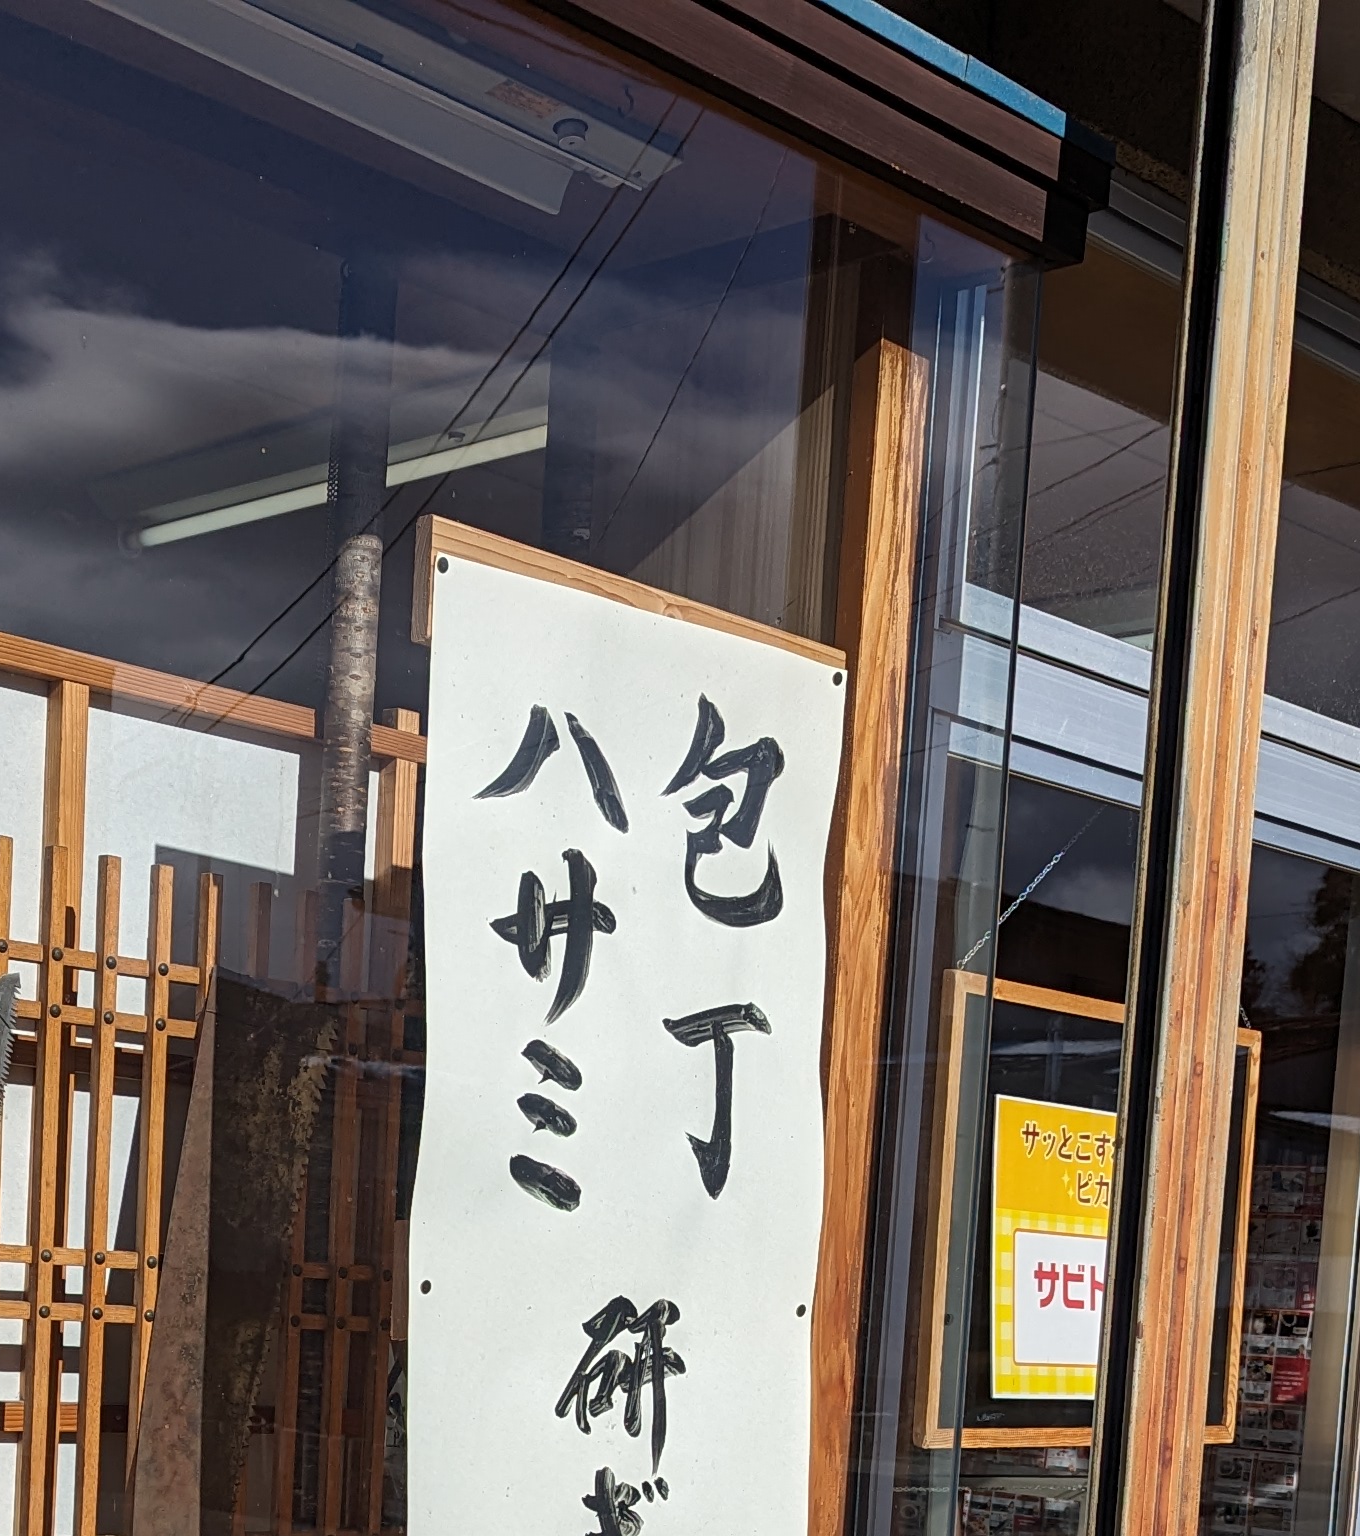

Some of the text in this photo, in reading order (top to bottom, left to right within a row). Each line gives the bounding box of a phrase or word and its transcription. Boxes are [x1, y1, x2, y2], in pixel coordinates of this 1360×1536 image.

[474, 705, 628, 1211] ハサミ
[662, 692, 785, 1199] 包丁
[1021, 1121, 1118, 1163] サッとこす
